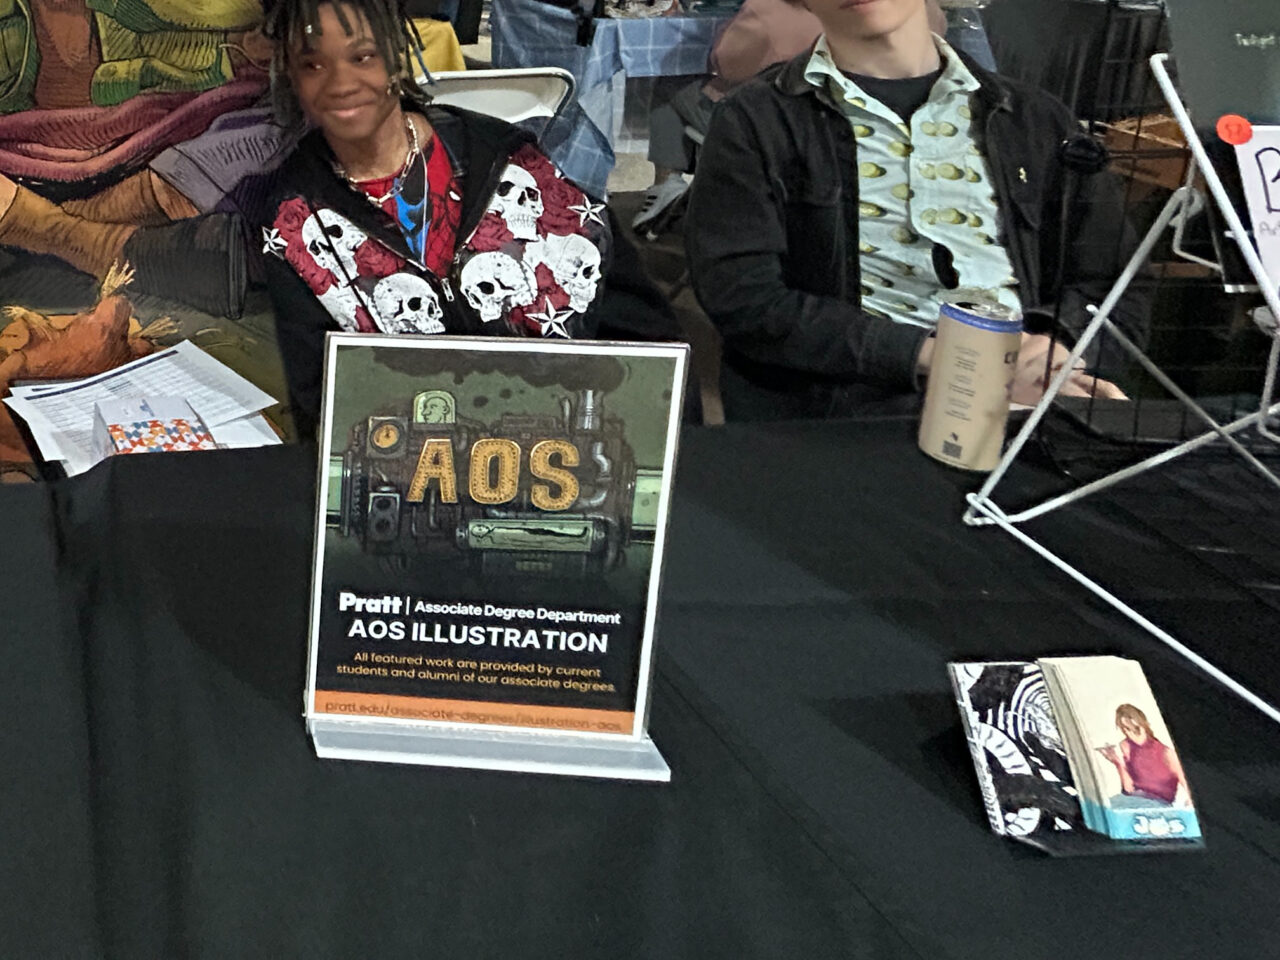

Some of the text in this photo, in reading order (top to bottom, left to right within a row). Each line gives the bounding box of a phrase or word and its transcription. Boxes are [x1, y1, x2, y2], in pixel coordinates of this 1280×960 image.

[406, 438, 580, 511] AOS
[339, 592, 621, 625] Pratt Associate Degree Department
[348, 619, 608, 653] AOS ILLUSTRATION
[336, 664, 388, 676] students
[391, 666, 415, 678] and
[418, 669, 460, 681] alumni
[463, 672, 475, 682] of
[477, 674, 498, 684] our
[500, 675, 560, 688] associate
[354, 652, 601, 678] All featured work are provided by current
